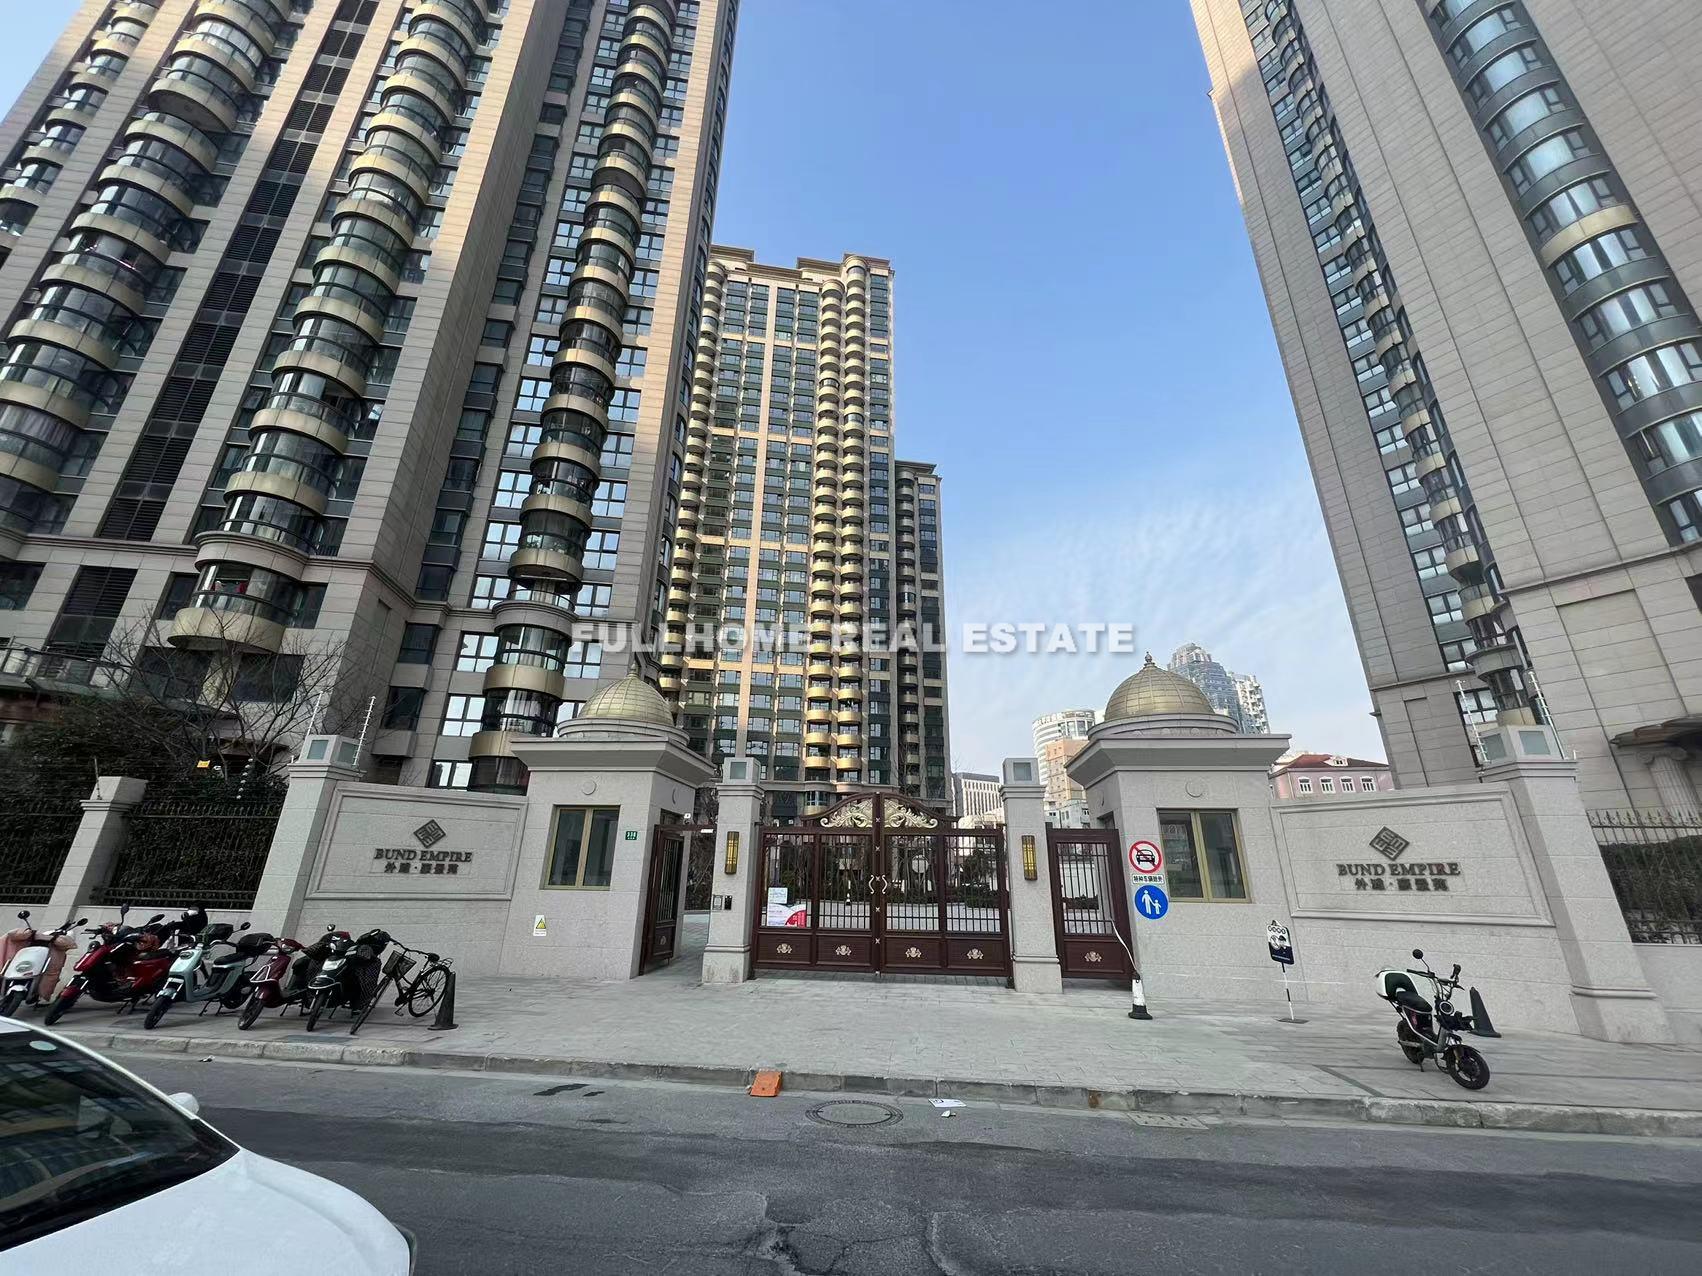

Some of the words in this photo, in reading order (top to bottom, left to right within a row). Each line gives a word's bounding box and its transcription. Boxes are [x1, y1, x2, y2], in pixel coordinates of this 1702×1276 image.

[374, 848, 418, 861] BUND
[419, 850, 473, 863] EMPIRE
[1336, 863, 1386, 877] BUND
[1388, 862, 1461, 877] EMPIRE
